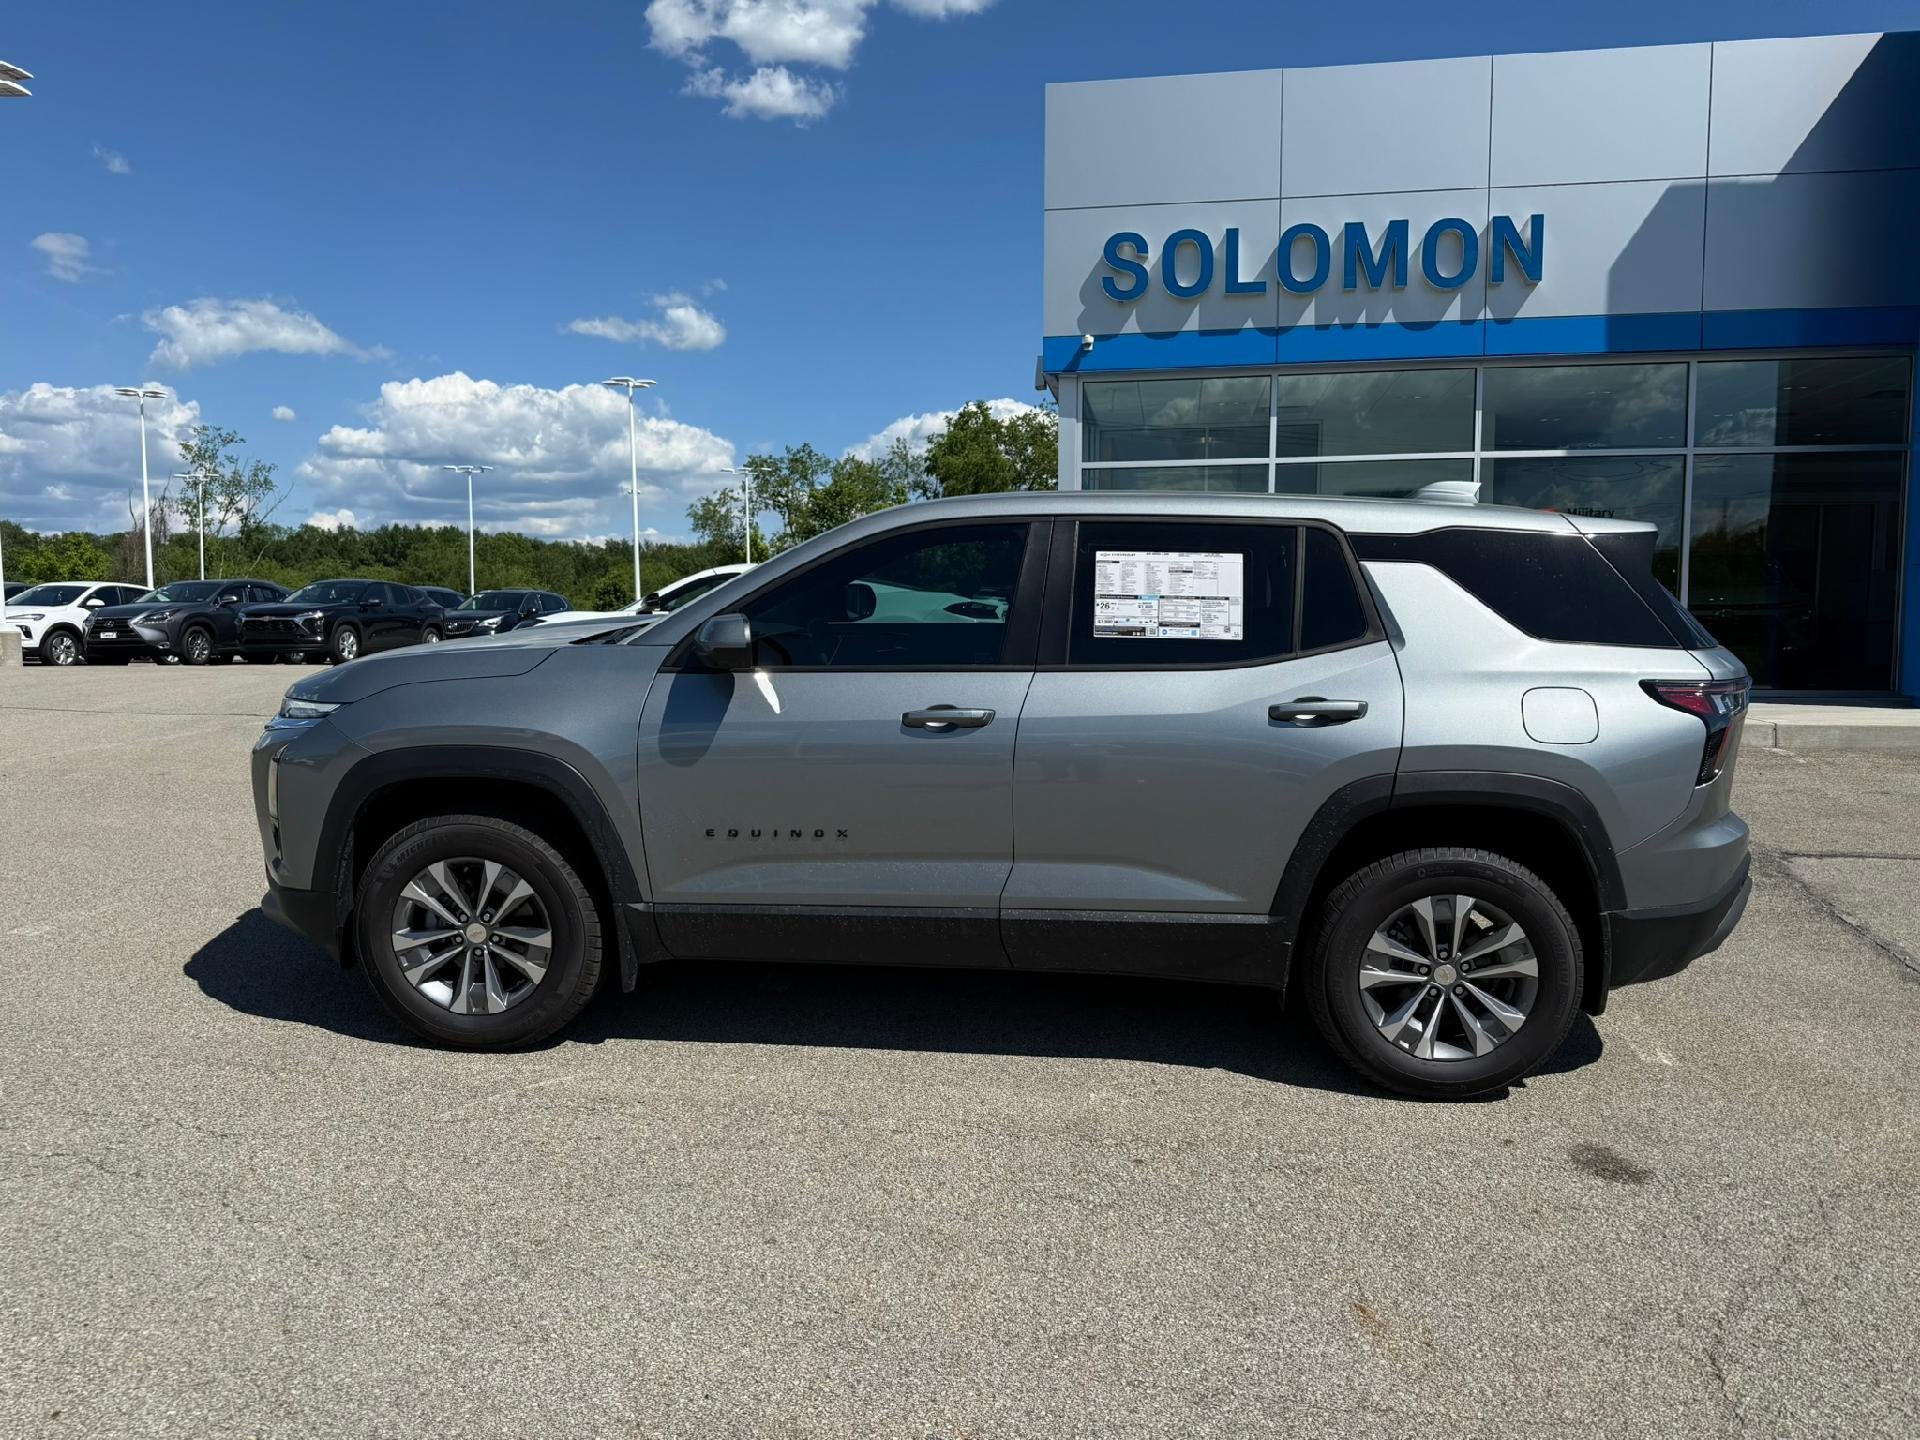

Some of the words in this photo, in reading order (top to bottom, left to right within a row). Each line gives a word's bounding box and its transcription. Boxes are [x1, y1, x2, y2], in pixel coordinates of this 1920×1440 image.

[1101, 214, 1545, 303] SOLOMON
[1567, 507, 1615, 518] Military
[705, 829, 848, 838] EQUINOX
